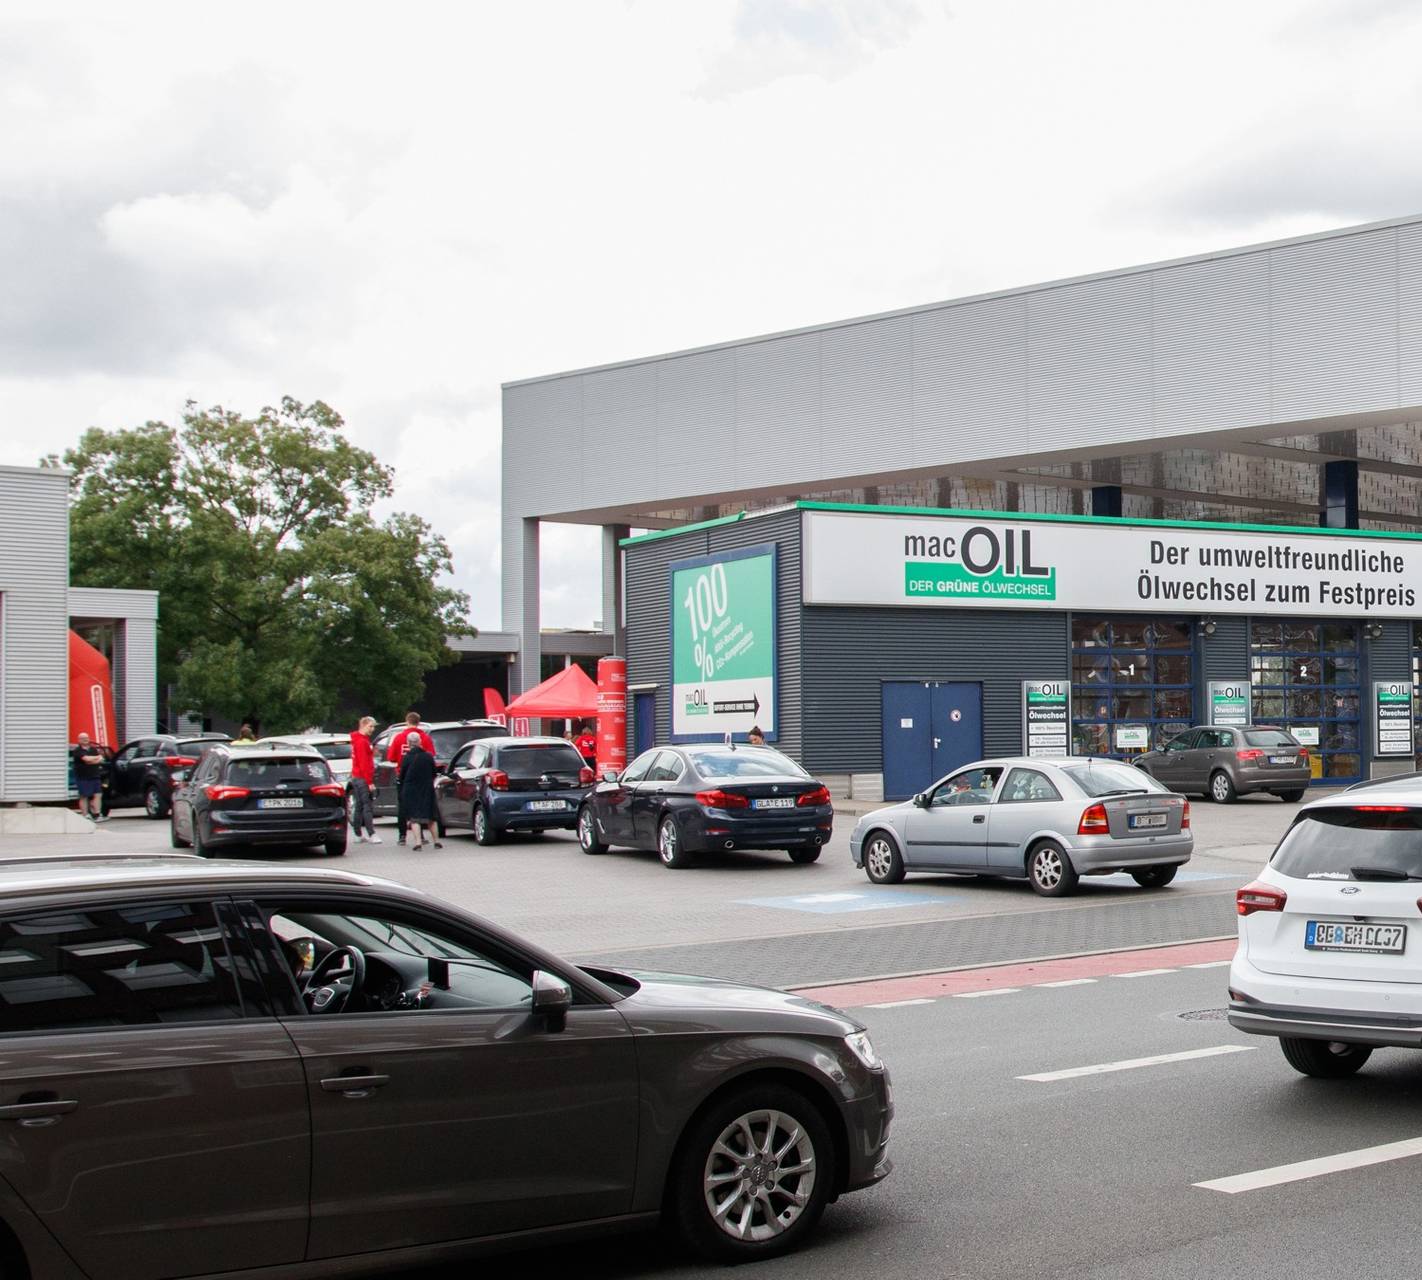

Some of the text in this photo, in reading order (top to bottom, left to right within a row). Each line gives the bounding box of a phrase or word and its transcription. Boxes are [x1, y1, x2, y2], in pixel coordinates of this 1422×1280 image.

[905, 526, 1048, 575] mac OIL
[1150, 540, 1404, 573] Der umweltfreundliche
[909, 579, 1051, 595] DER GRÜNE ÖLWECHSEL
[1137, 569, 1415, 610] Ölwechsel zum Festpreis
[684, 563, 728, 641] 100
[1129, 663, 1135, 676] 1
[1300, 665, 1307, 677] 2
[1042, 684, 1064, 696] OIL
[1226, 687, 1244, 699] OIL
[1390, 684, 1408, 696] OIL
[694, 689, 708, 706] OIL
[1029, 711, 1066, 719] Ölwechsel
[1379, 708, 1410, 717] Ölwechsel
[756, 799, 770, 809] GLA
